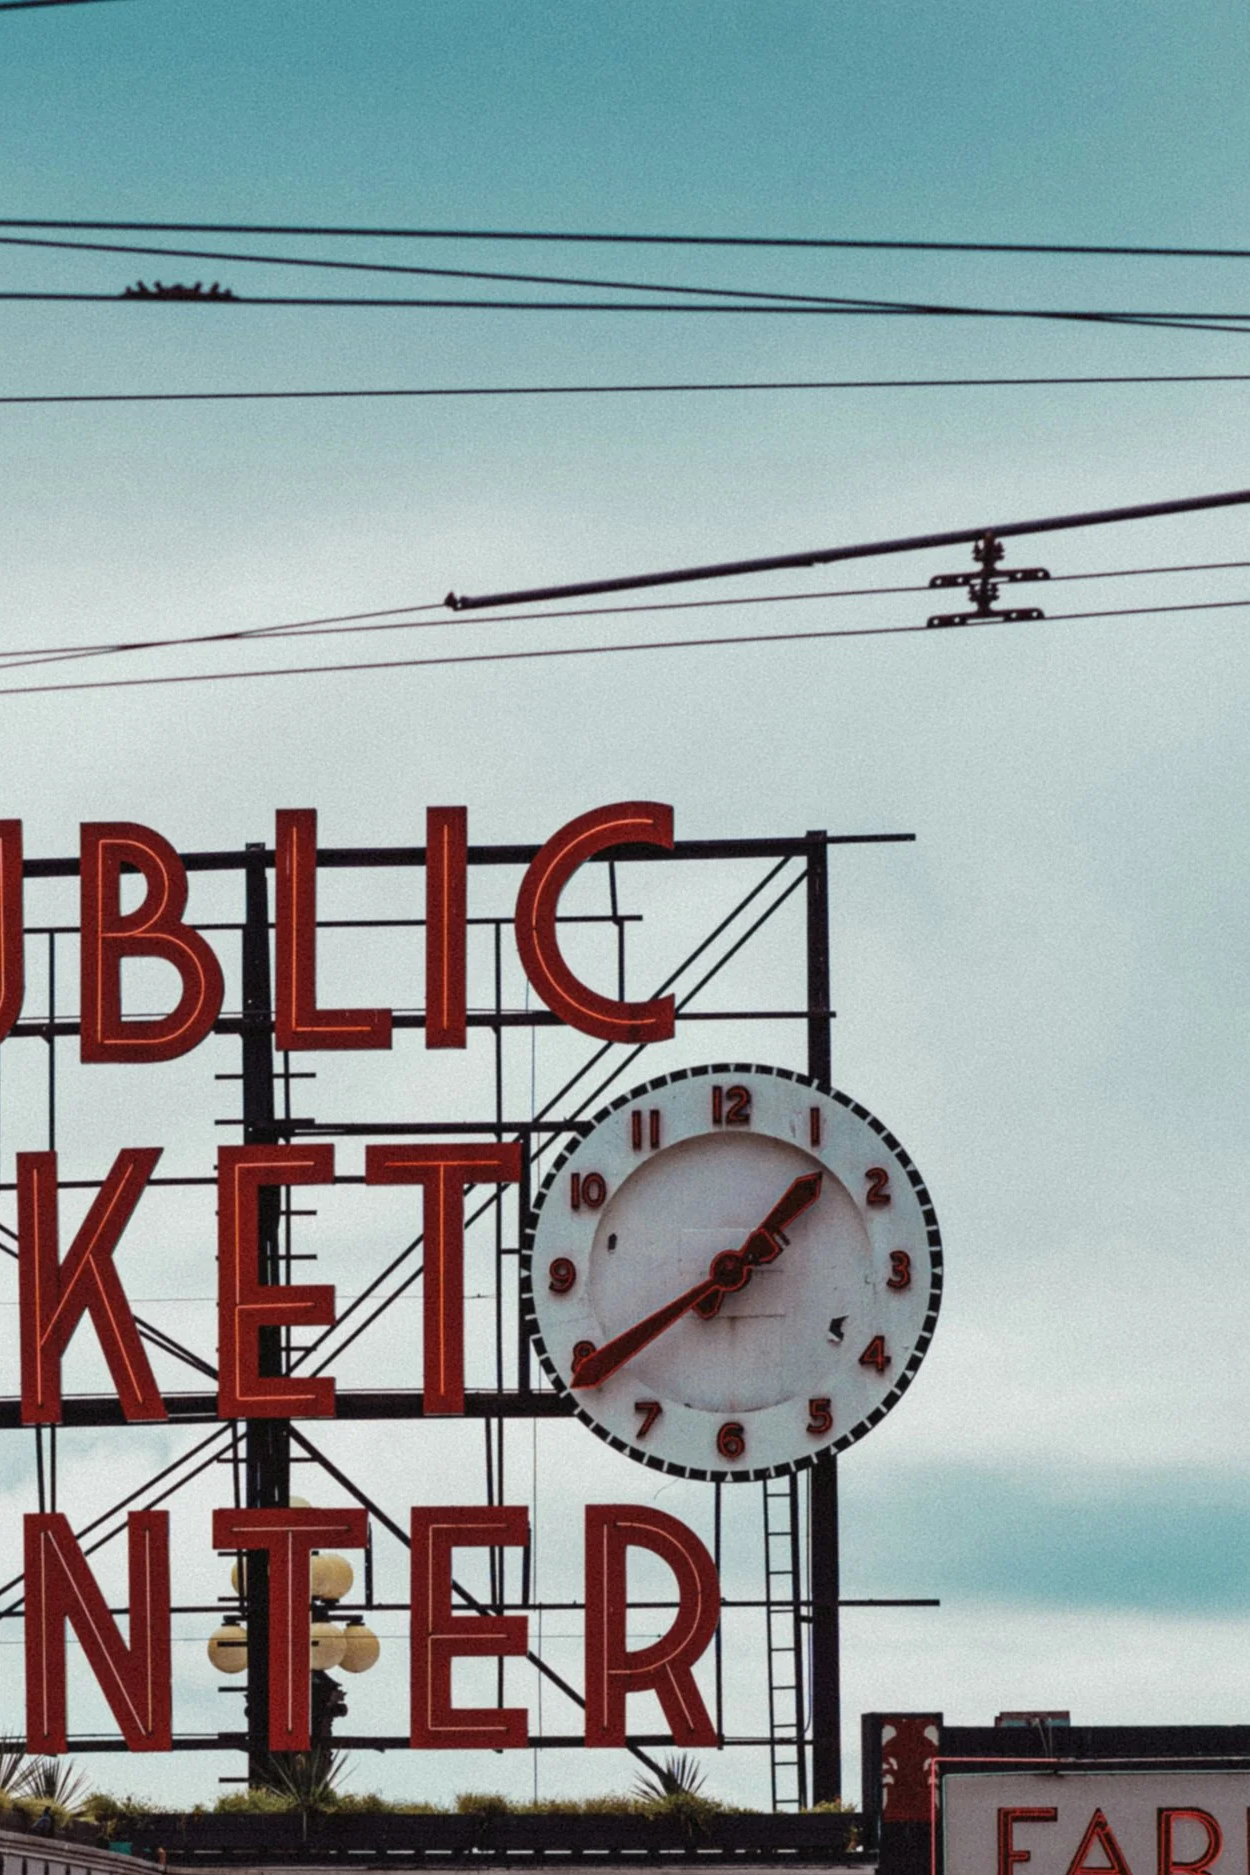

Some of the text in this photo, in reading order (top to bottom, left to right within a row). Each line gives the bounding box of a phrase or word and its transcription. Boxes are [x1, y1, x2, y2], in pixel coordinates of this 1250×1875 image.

[712, 1086, 751, 1125] 12
[631, 1109, 661, 1150] 11
[809, 1107, 821, 1147] 1
[570, 1173, 607, 1211] 10
[865, 1167, 891, 1206] 2
[548, 1257, 577, 1294] 9
[887, 1251, 911, 1290] 3
[859, 1335, 891, 1372] 4
[634, 1402, 663, 1438] 7
[807, 1399, 832, 1435] 5
[717, 1423, 745, 1460] 6
